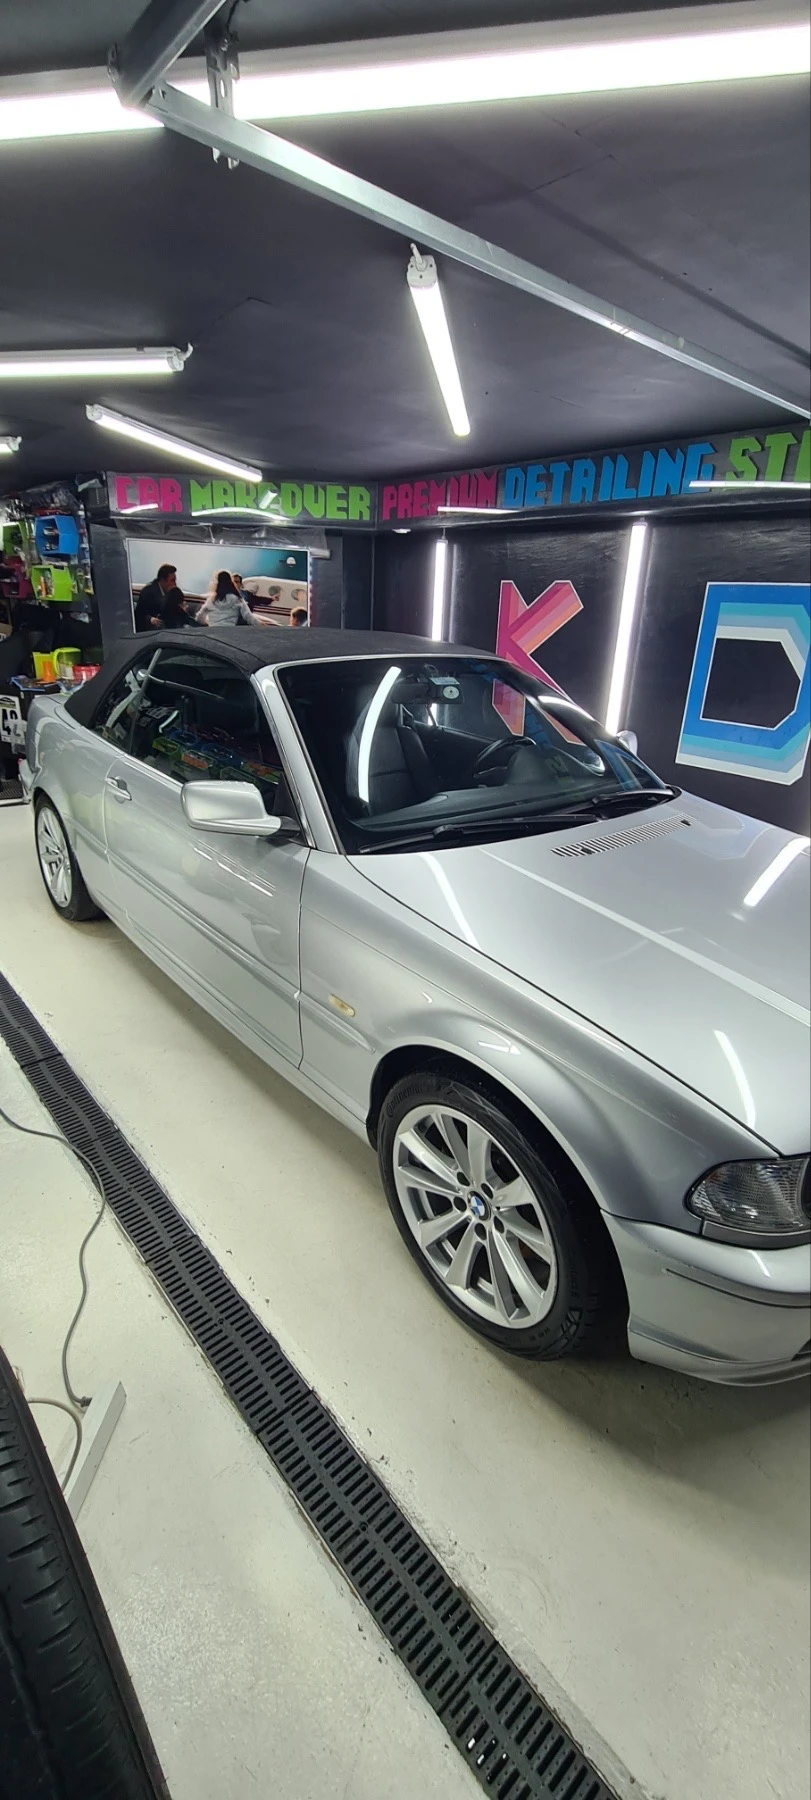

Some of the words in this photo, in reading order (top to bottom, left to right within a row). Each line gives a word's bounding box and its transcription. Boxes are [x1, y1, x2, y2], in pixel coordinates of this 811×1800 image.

[114, 475, 182, 513] CAR
[382, 470, 498, 521] PREMIUM
[504, 442, 715, 509] DETAILING
